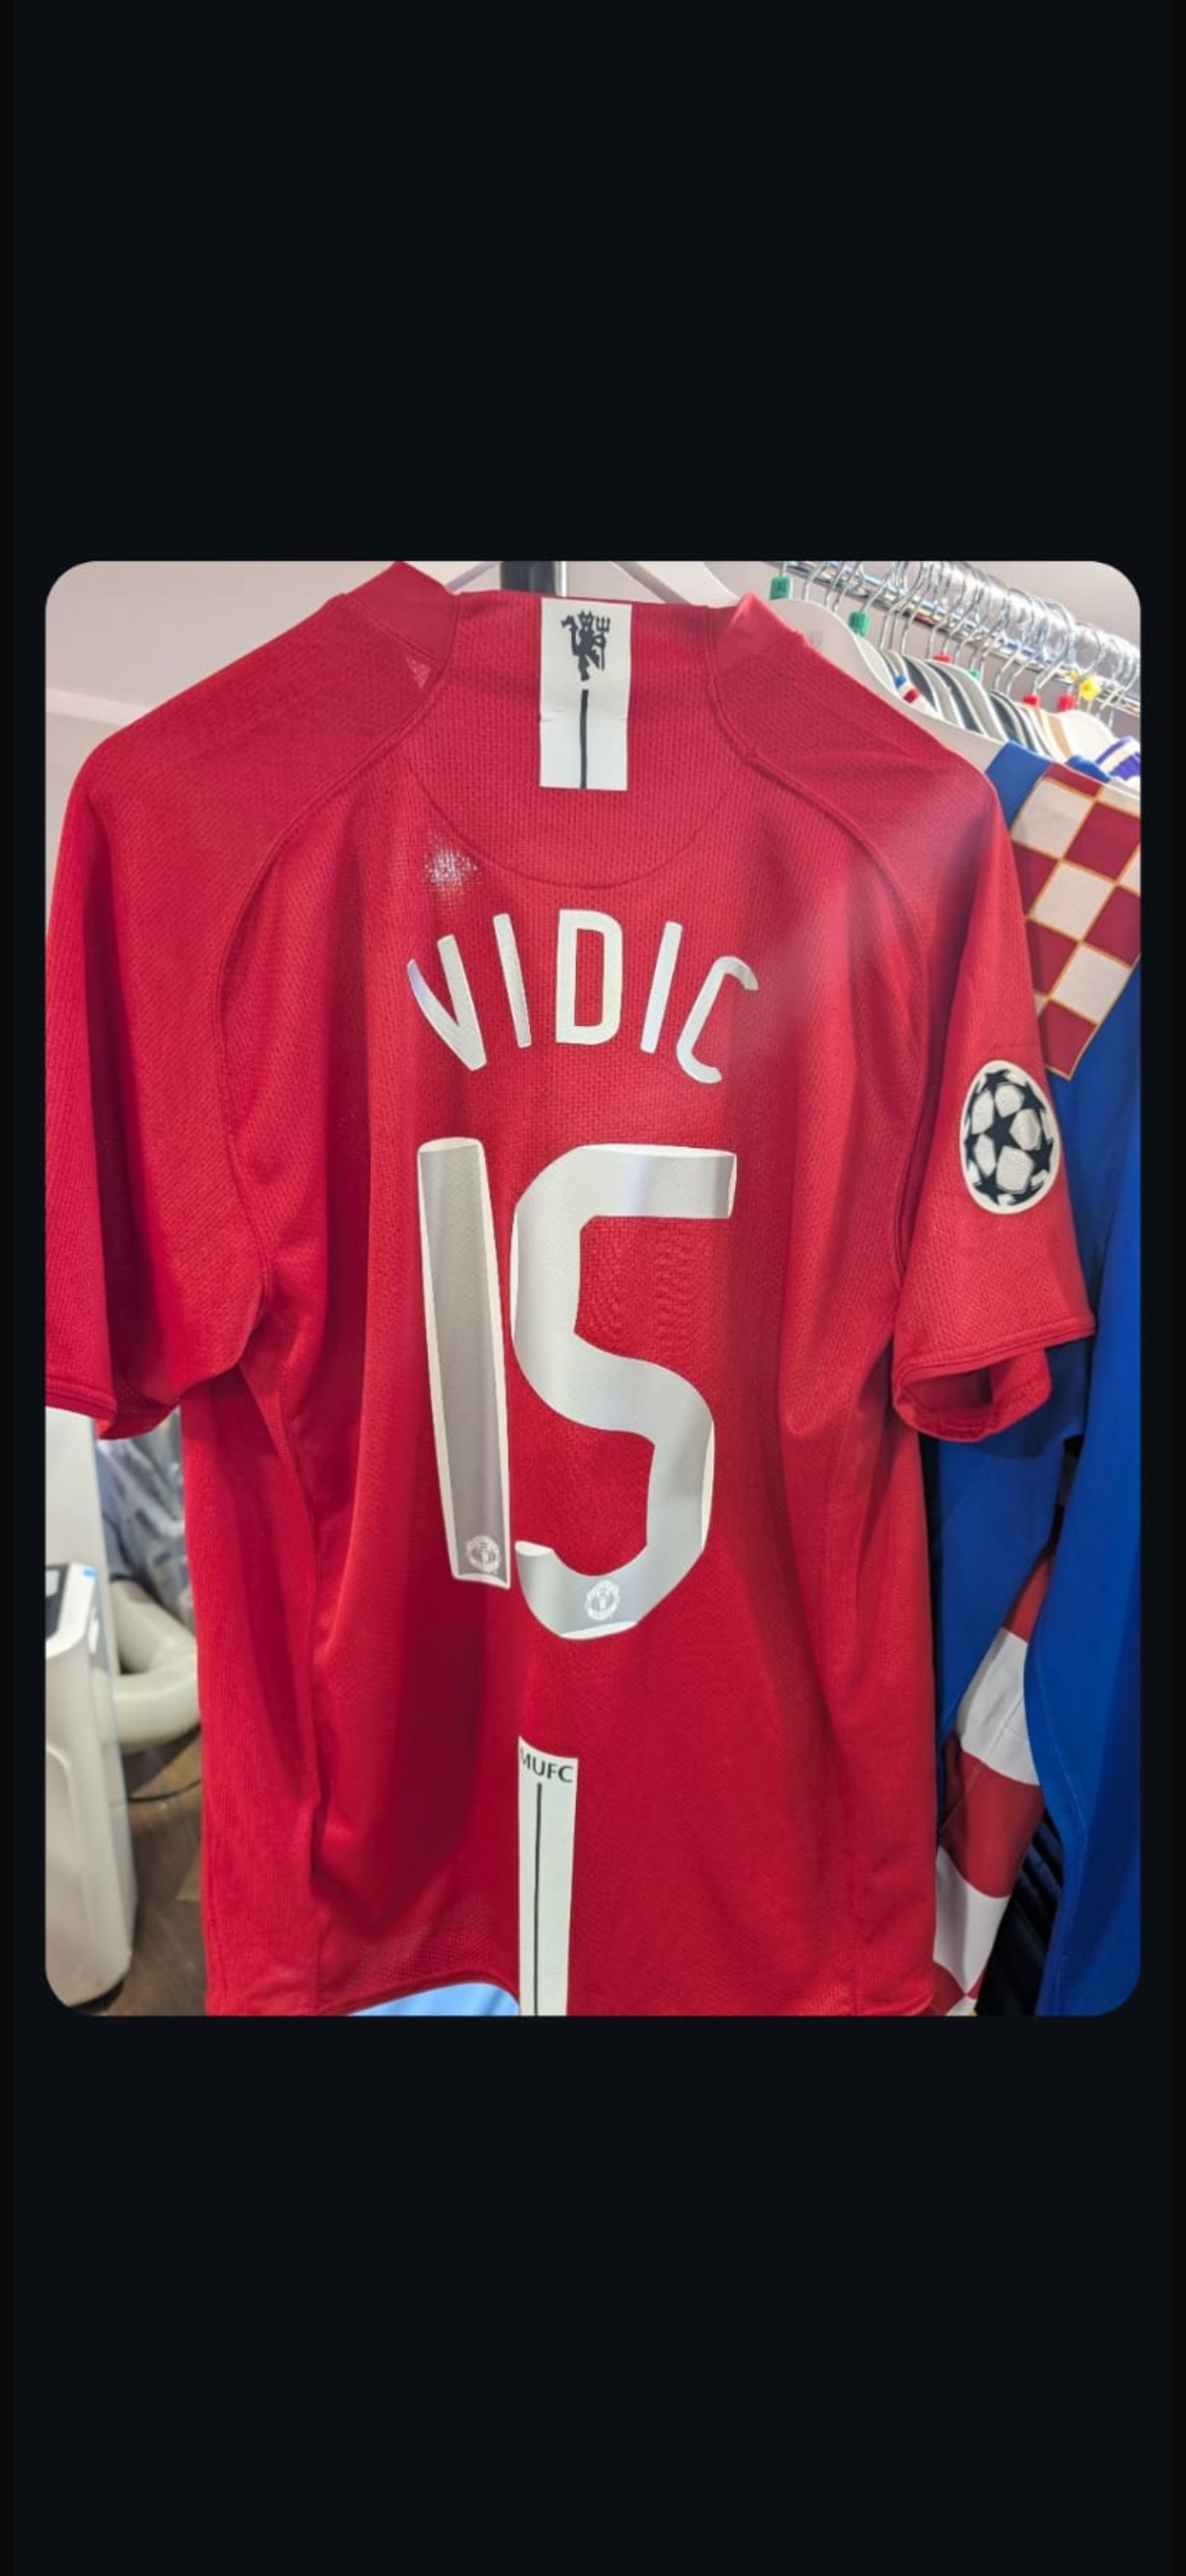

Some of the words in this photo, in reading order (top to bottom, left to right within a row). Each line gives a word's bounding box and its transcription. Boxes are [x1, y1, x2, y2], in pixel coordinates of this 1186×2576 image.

[406, 908, 759, 1085] VIDIC
[417, 1136, 737, 1640] 15
[519, 1746, 574, 1783] MUFC
